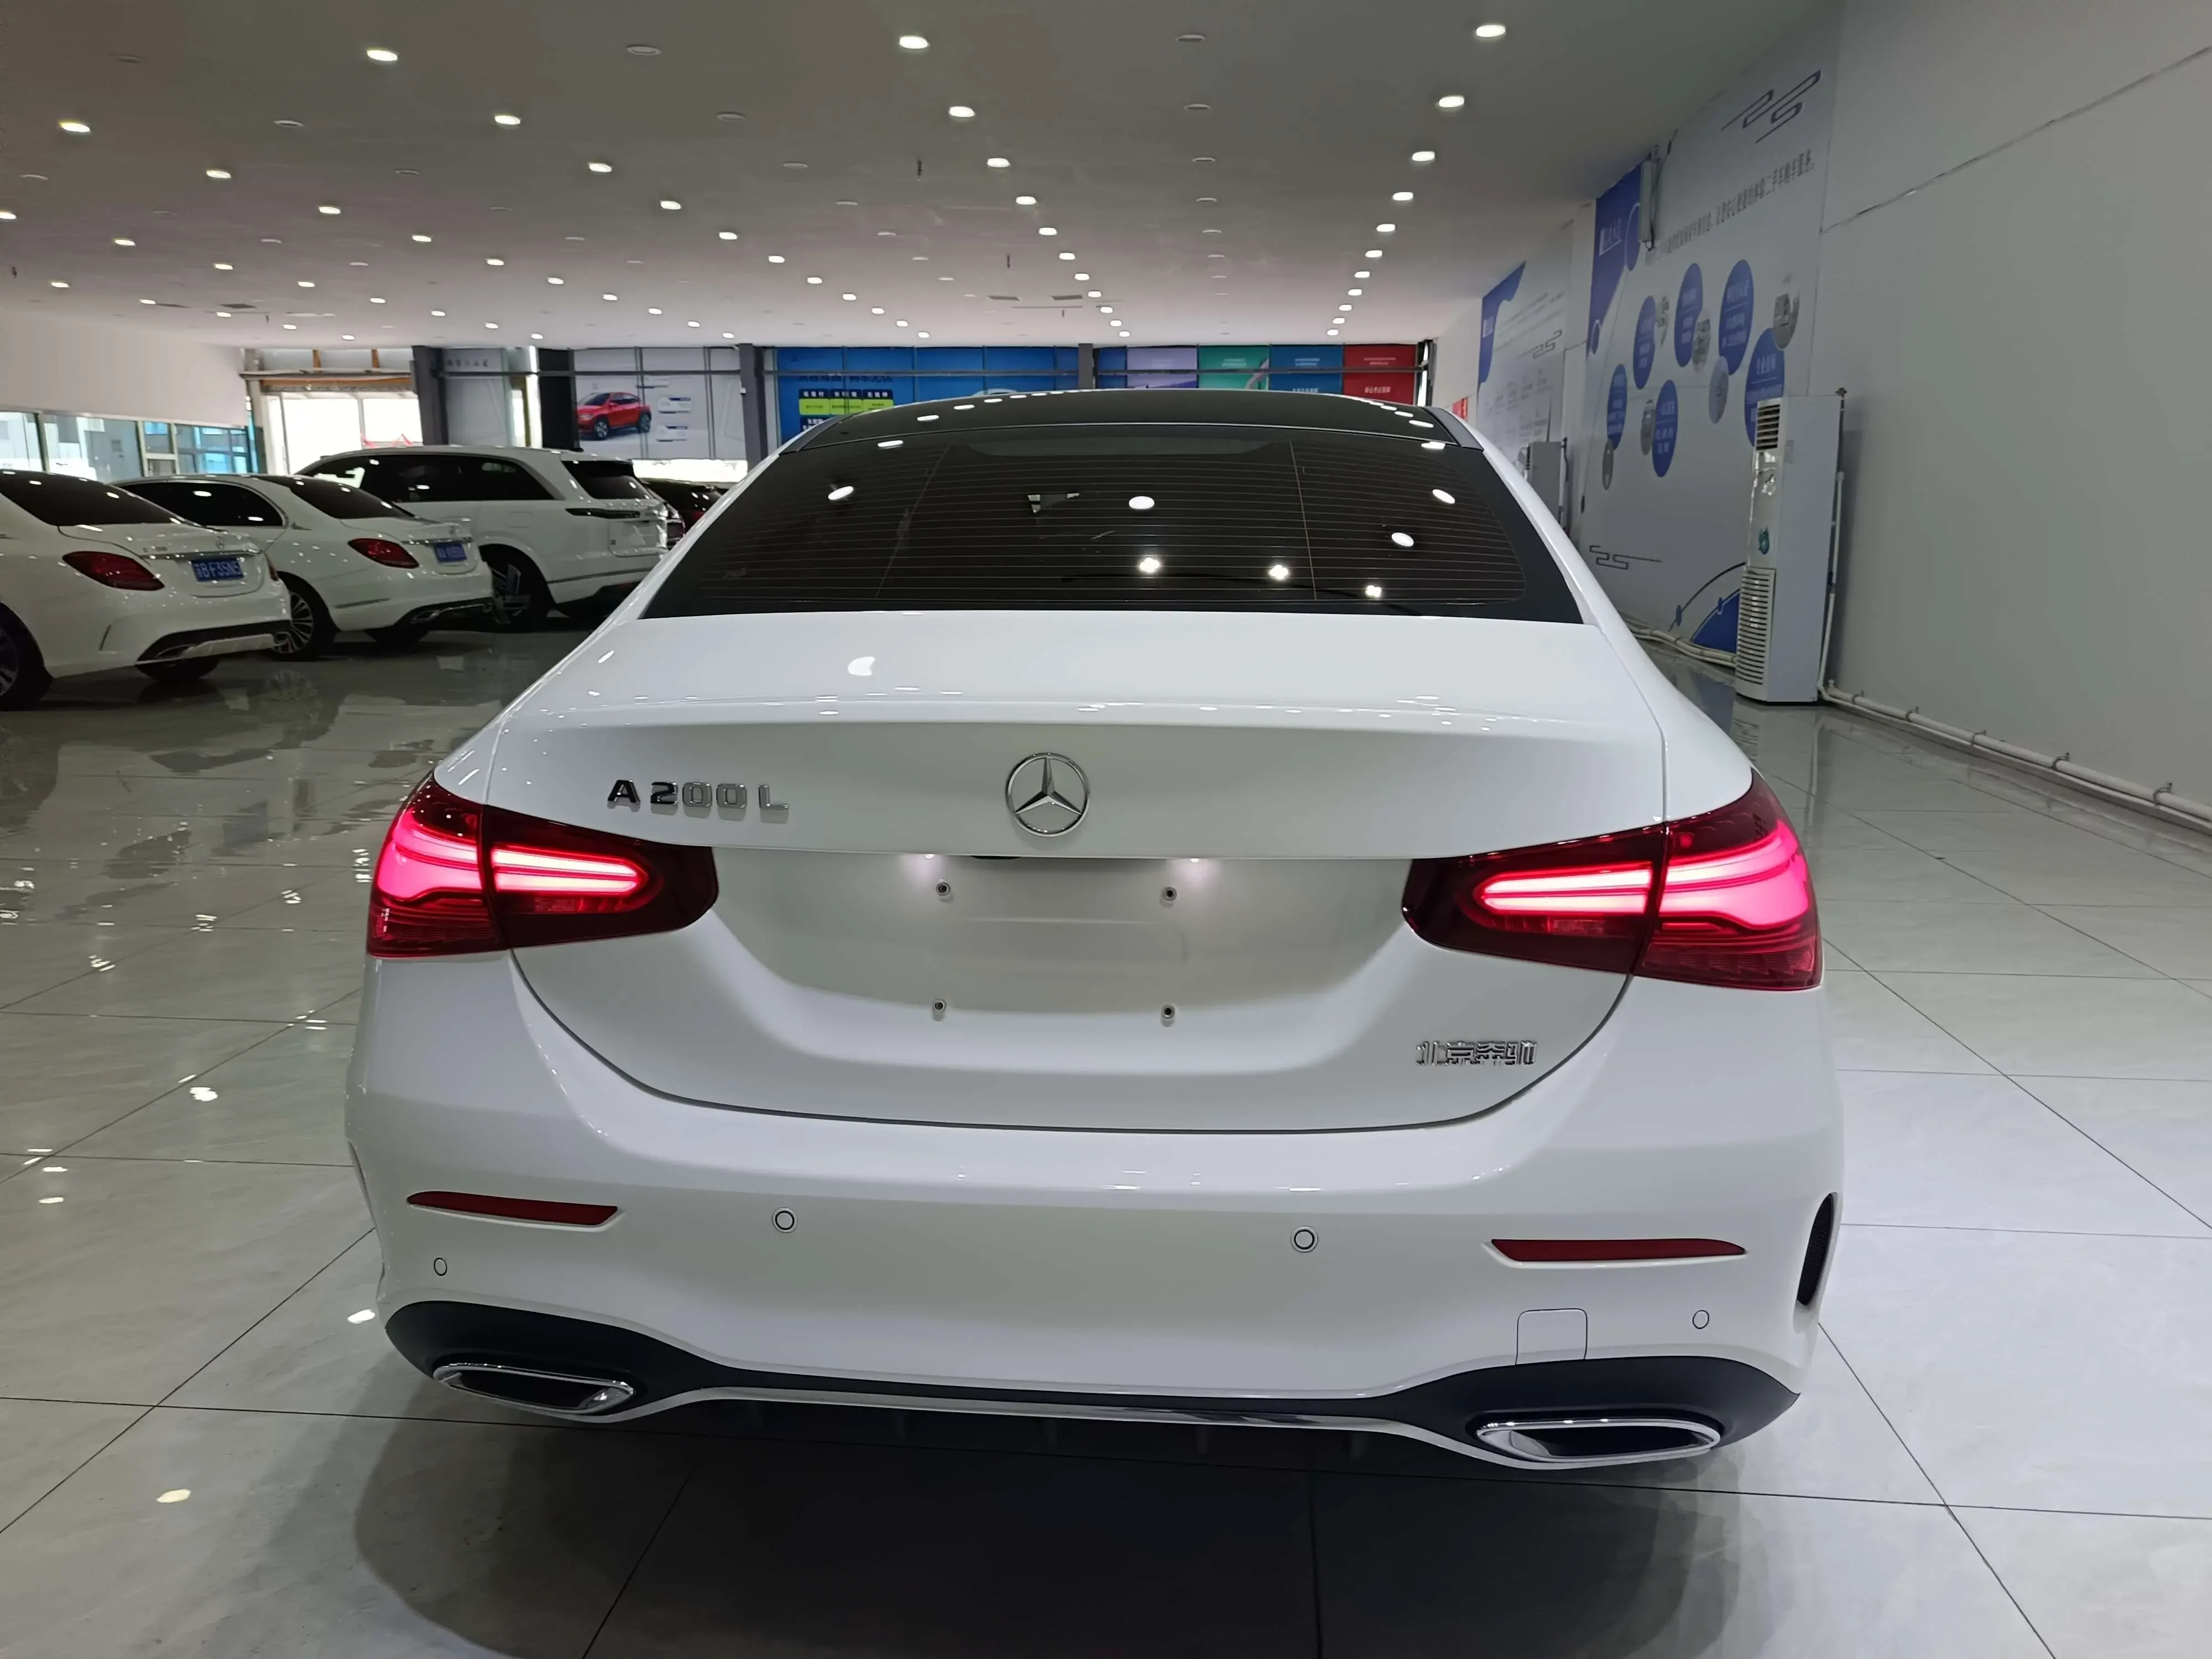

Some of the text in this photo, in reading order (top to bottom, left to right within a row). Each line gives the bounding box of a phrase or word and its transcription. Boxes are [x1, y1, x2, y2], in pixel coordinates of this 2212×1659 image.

[607, 779, 789, 810] A 200 L
[1416, 1040, 1537, 1066] 北京奔驰
